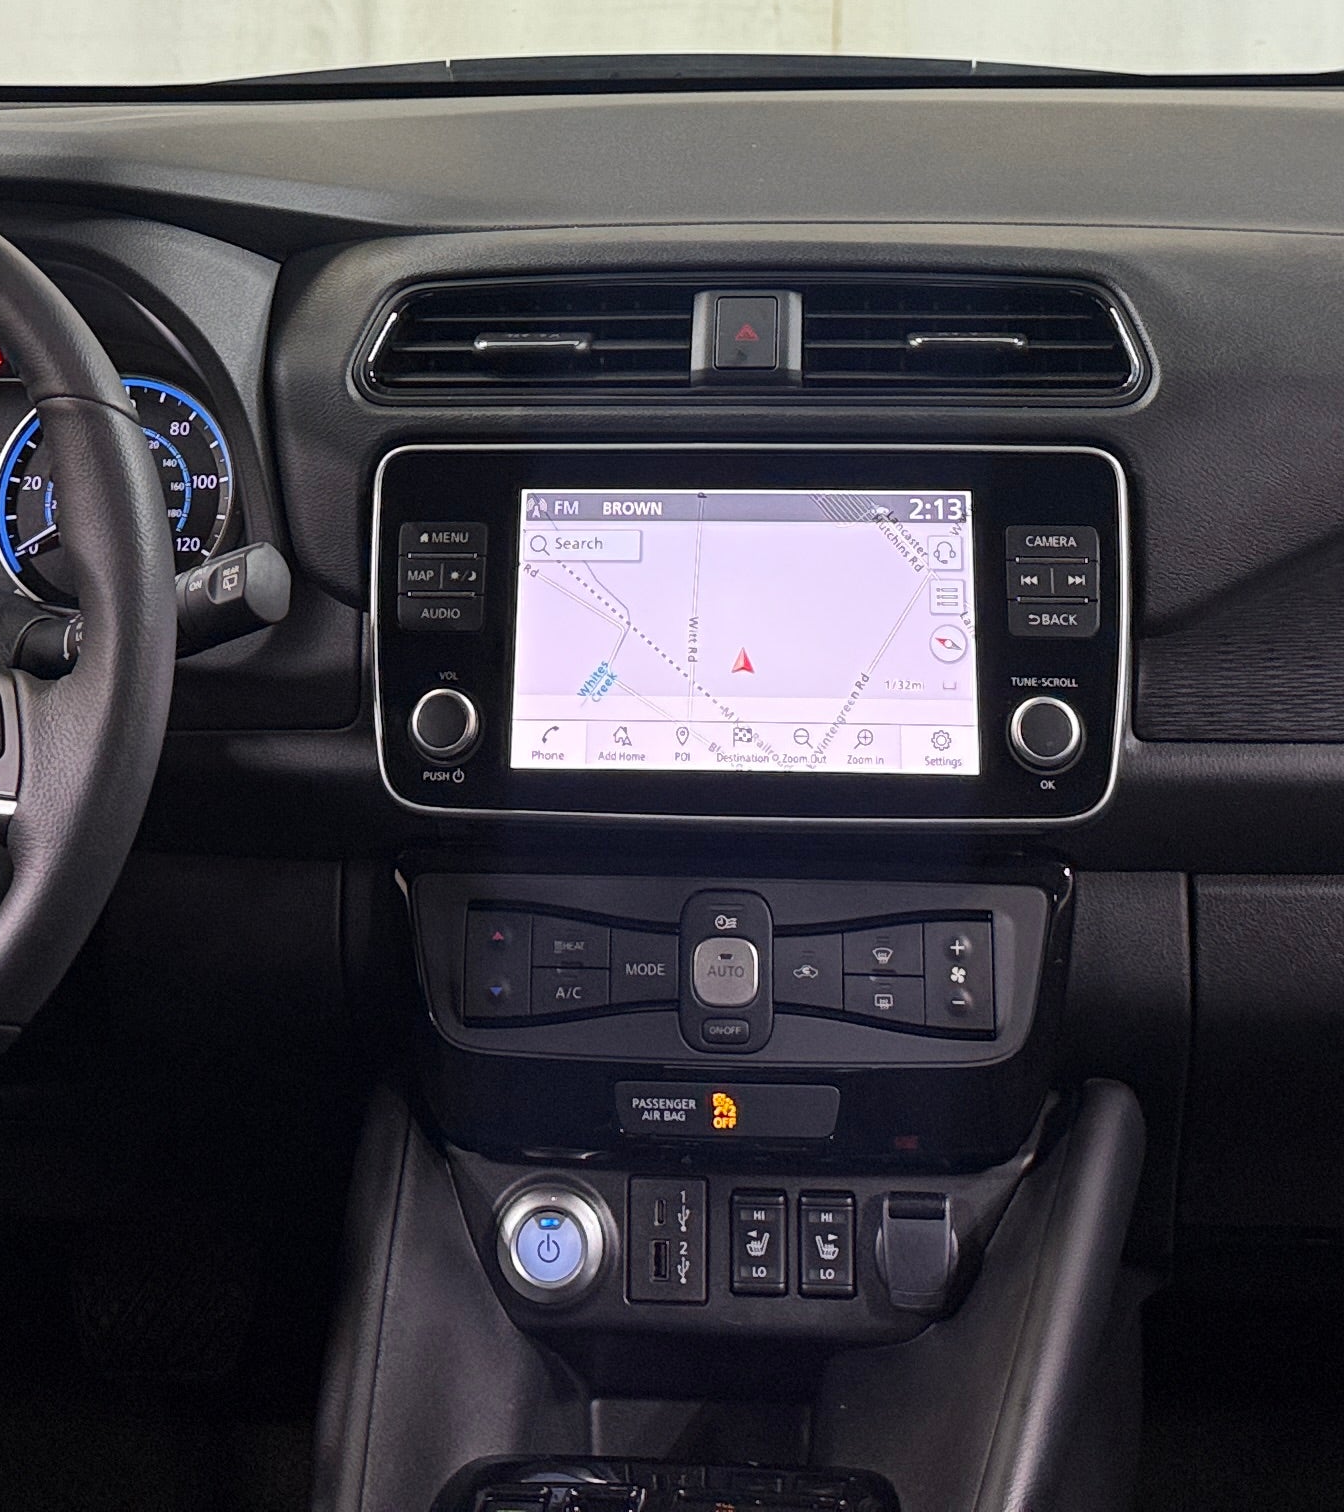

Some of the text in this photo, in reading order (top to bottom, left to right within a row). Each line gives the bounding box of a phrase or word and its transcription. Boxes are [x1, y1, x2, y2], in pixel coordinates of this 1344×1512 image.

[169, 421, 191, 436] 80
[161, 458, 178, 468] 140
[22, 475, 43, 491] 20
[170, 481, 185, 492] 160
[192, 474, 218, 490] 100
[554, 500, 663, 516] FM BROWN
[908, 497, 963, 521] 2:13
[431, 531, 469, 544] MENU
[886, 510, 929, 559] Lancaster
[176, 537, 201, 552] 120
[555, 536, 604, 551] Search
[1025, 535, 1078, 548] CAMERA
[28, 543, 39, 555] 0
[222, 564, 240, 577] REAR
[523, 563, 540, 578] Rd
[908, 555, 925, 573] Rd
[407, 570, 435, 581] MAP
[188, 579, 203, 592] ON
[420, 607, 461, 619] AUDIO
[1041, 613, 1078, 626] BACK
[687, 646, 699, 663] Rd
[439, 672, 458, 681] VOL
[576, 660, 609, 698] Whites
[855, 672, 870, 691] Rd
[591, 671, 618, 703] Creek
[531, 750, 565, 761] Phone
[598, 751, 646, 762] Add Home
[674, 751, 692, 762] POI
[716, 752, 770, 764] Destination
[782, 753, 827, 764] Zoom Out
[847, 754, 874, 765] Zoom
[924, 755, 963, 769] Settings
[422, 770, 450, 782] PUSH
[1040, 778, 1056, 790] OK
[625, 962, 666, 976] MODE
[707, 964, 745, 978] AUTO
[555, 986, 583, 1000] A/C
[632, 1097, 697, 1110] PASSENGER
[641, 1110, 686, 1122] AIR BAG
[712, 1116, 737, 1129] OFF
[680, 1190, 686, 1204] 1
[753, 1210, 766, 1221] HI
[820, 1212, 833, 1223] HI
[679, 1241, 688, 1255] 2
[752, 1266, 768, 1278] LO
[819, 1268, 835, 1280] LO
